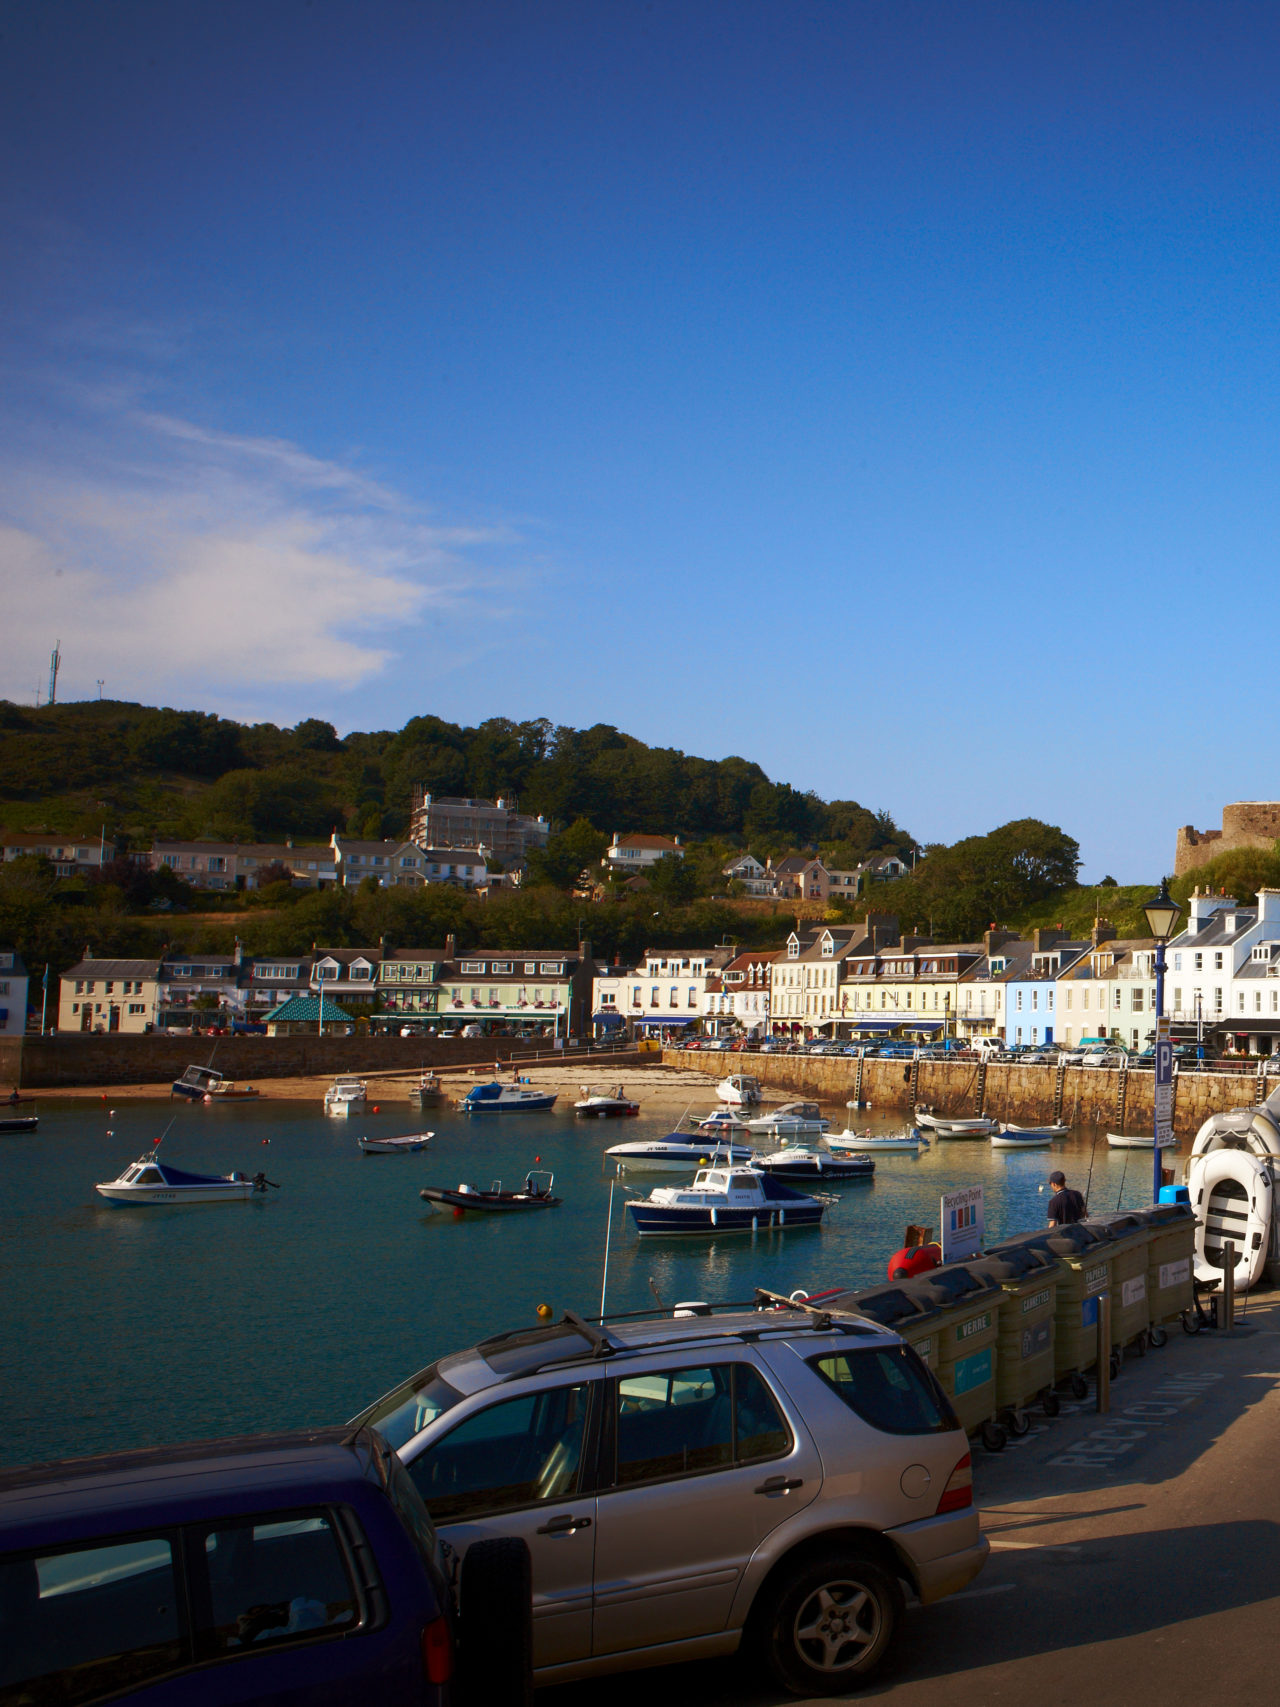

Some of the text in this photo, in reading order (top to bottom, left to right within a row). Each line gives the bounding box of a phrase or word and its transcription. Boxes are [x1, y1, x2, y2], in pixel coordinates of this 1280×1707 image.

[1160, 1046, 1170, 1081] P
[944, 1189, 981, 1209] Recycling Point
[962, 1315, 987, 1337] VERRE
[1046, 1371, 1225, 1469] RECYCLING
